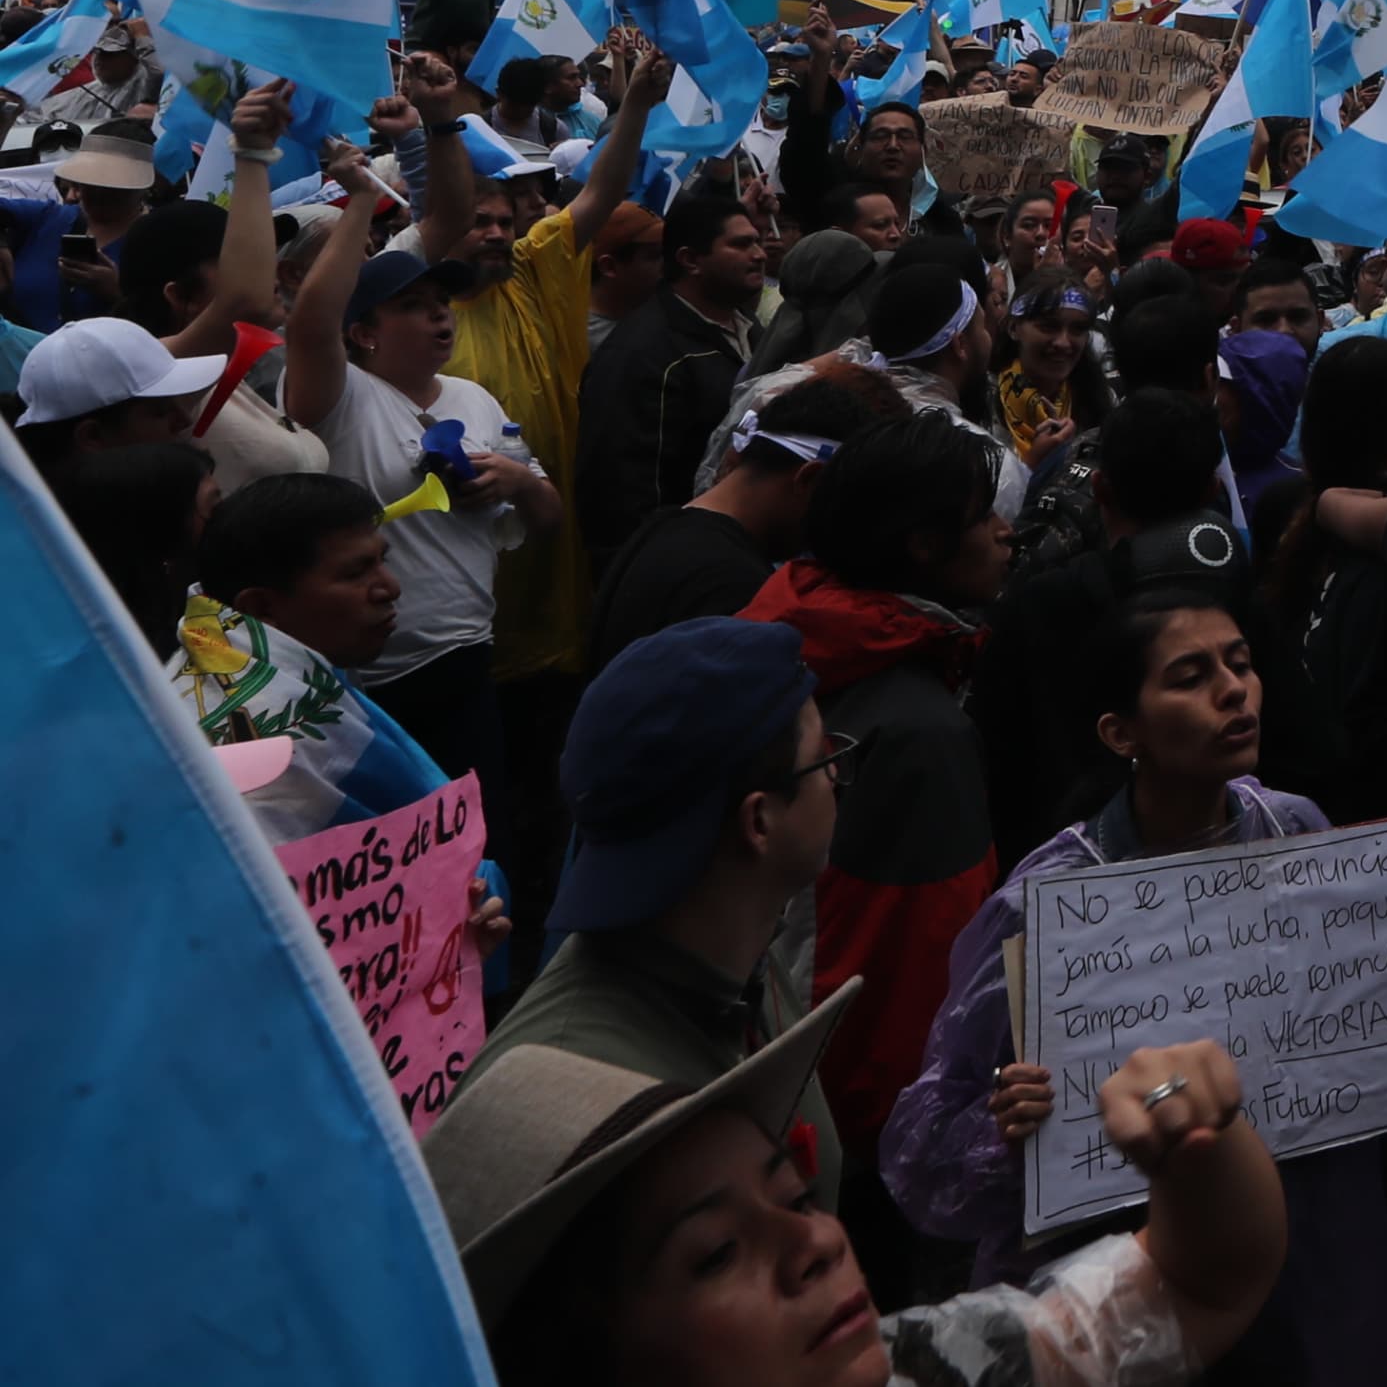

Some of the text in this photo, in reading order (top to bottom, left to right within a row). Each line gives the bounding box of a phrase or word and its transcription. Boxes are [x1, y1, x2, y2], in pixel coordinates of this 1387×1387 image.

[1098, 76, 1118, 100] NO
[1129, 79, 1150, 102] LOS
[1156, 84, 1183, 106] QUE
[305, 826, 394, 908] más
[401, 815, 430, 868] de
[1056, 884, 1110, 929] No
[1134, 878, 1166, 910] se
[1183, 857, 1266, 921] puede
[1055, 937, 1135, 998] jamás
[1149, 939, 1173, 964] a
[1184, 926, 1213, 959] la
[1055, 992, 1170, 1050] Tampoco
[1181, 983, 1210, 1014] se
[1223, 964, 1289, 1017] puede
[1226, 1021, 1248, 1059] la
